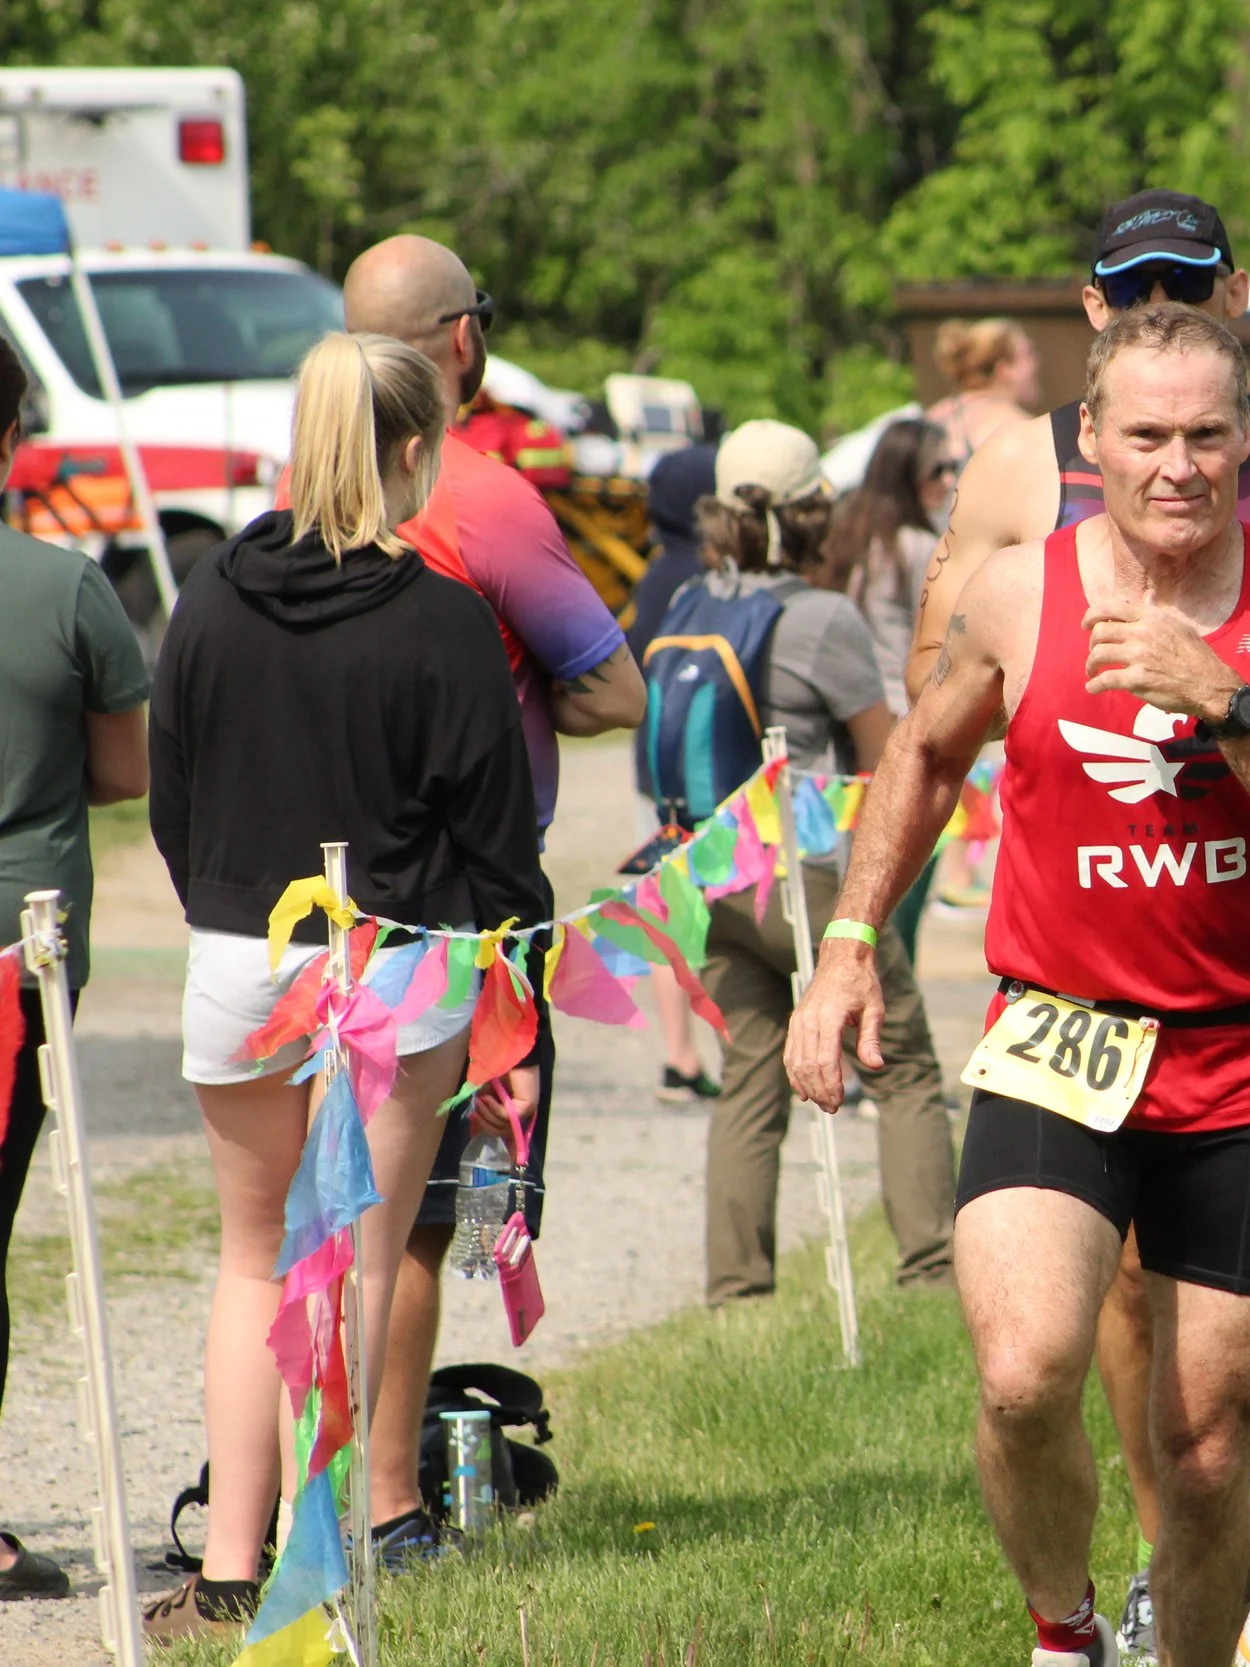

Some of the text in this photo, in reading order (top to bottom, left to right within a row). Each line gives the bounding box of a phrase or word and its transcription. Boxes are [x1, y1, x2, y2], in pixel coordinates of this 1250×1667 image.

[1128, 823, 1199, 838] TEAM
[1077, 836, 1247, 889] RWB
[1006, 1002, 1130, 1092] 286
